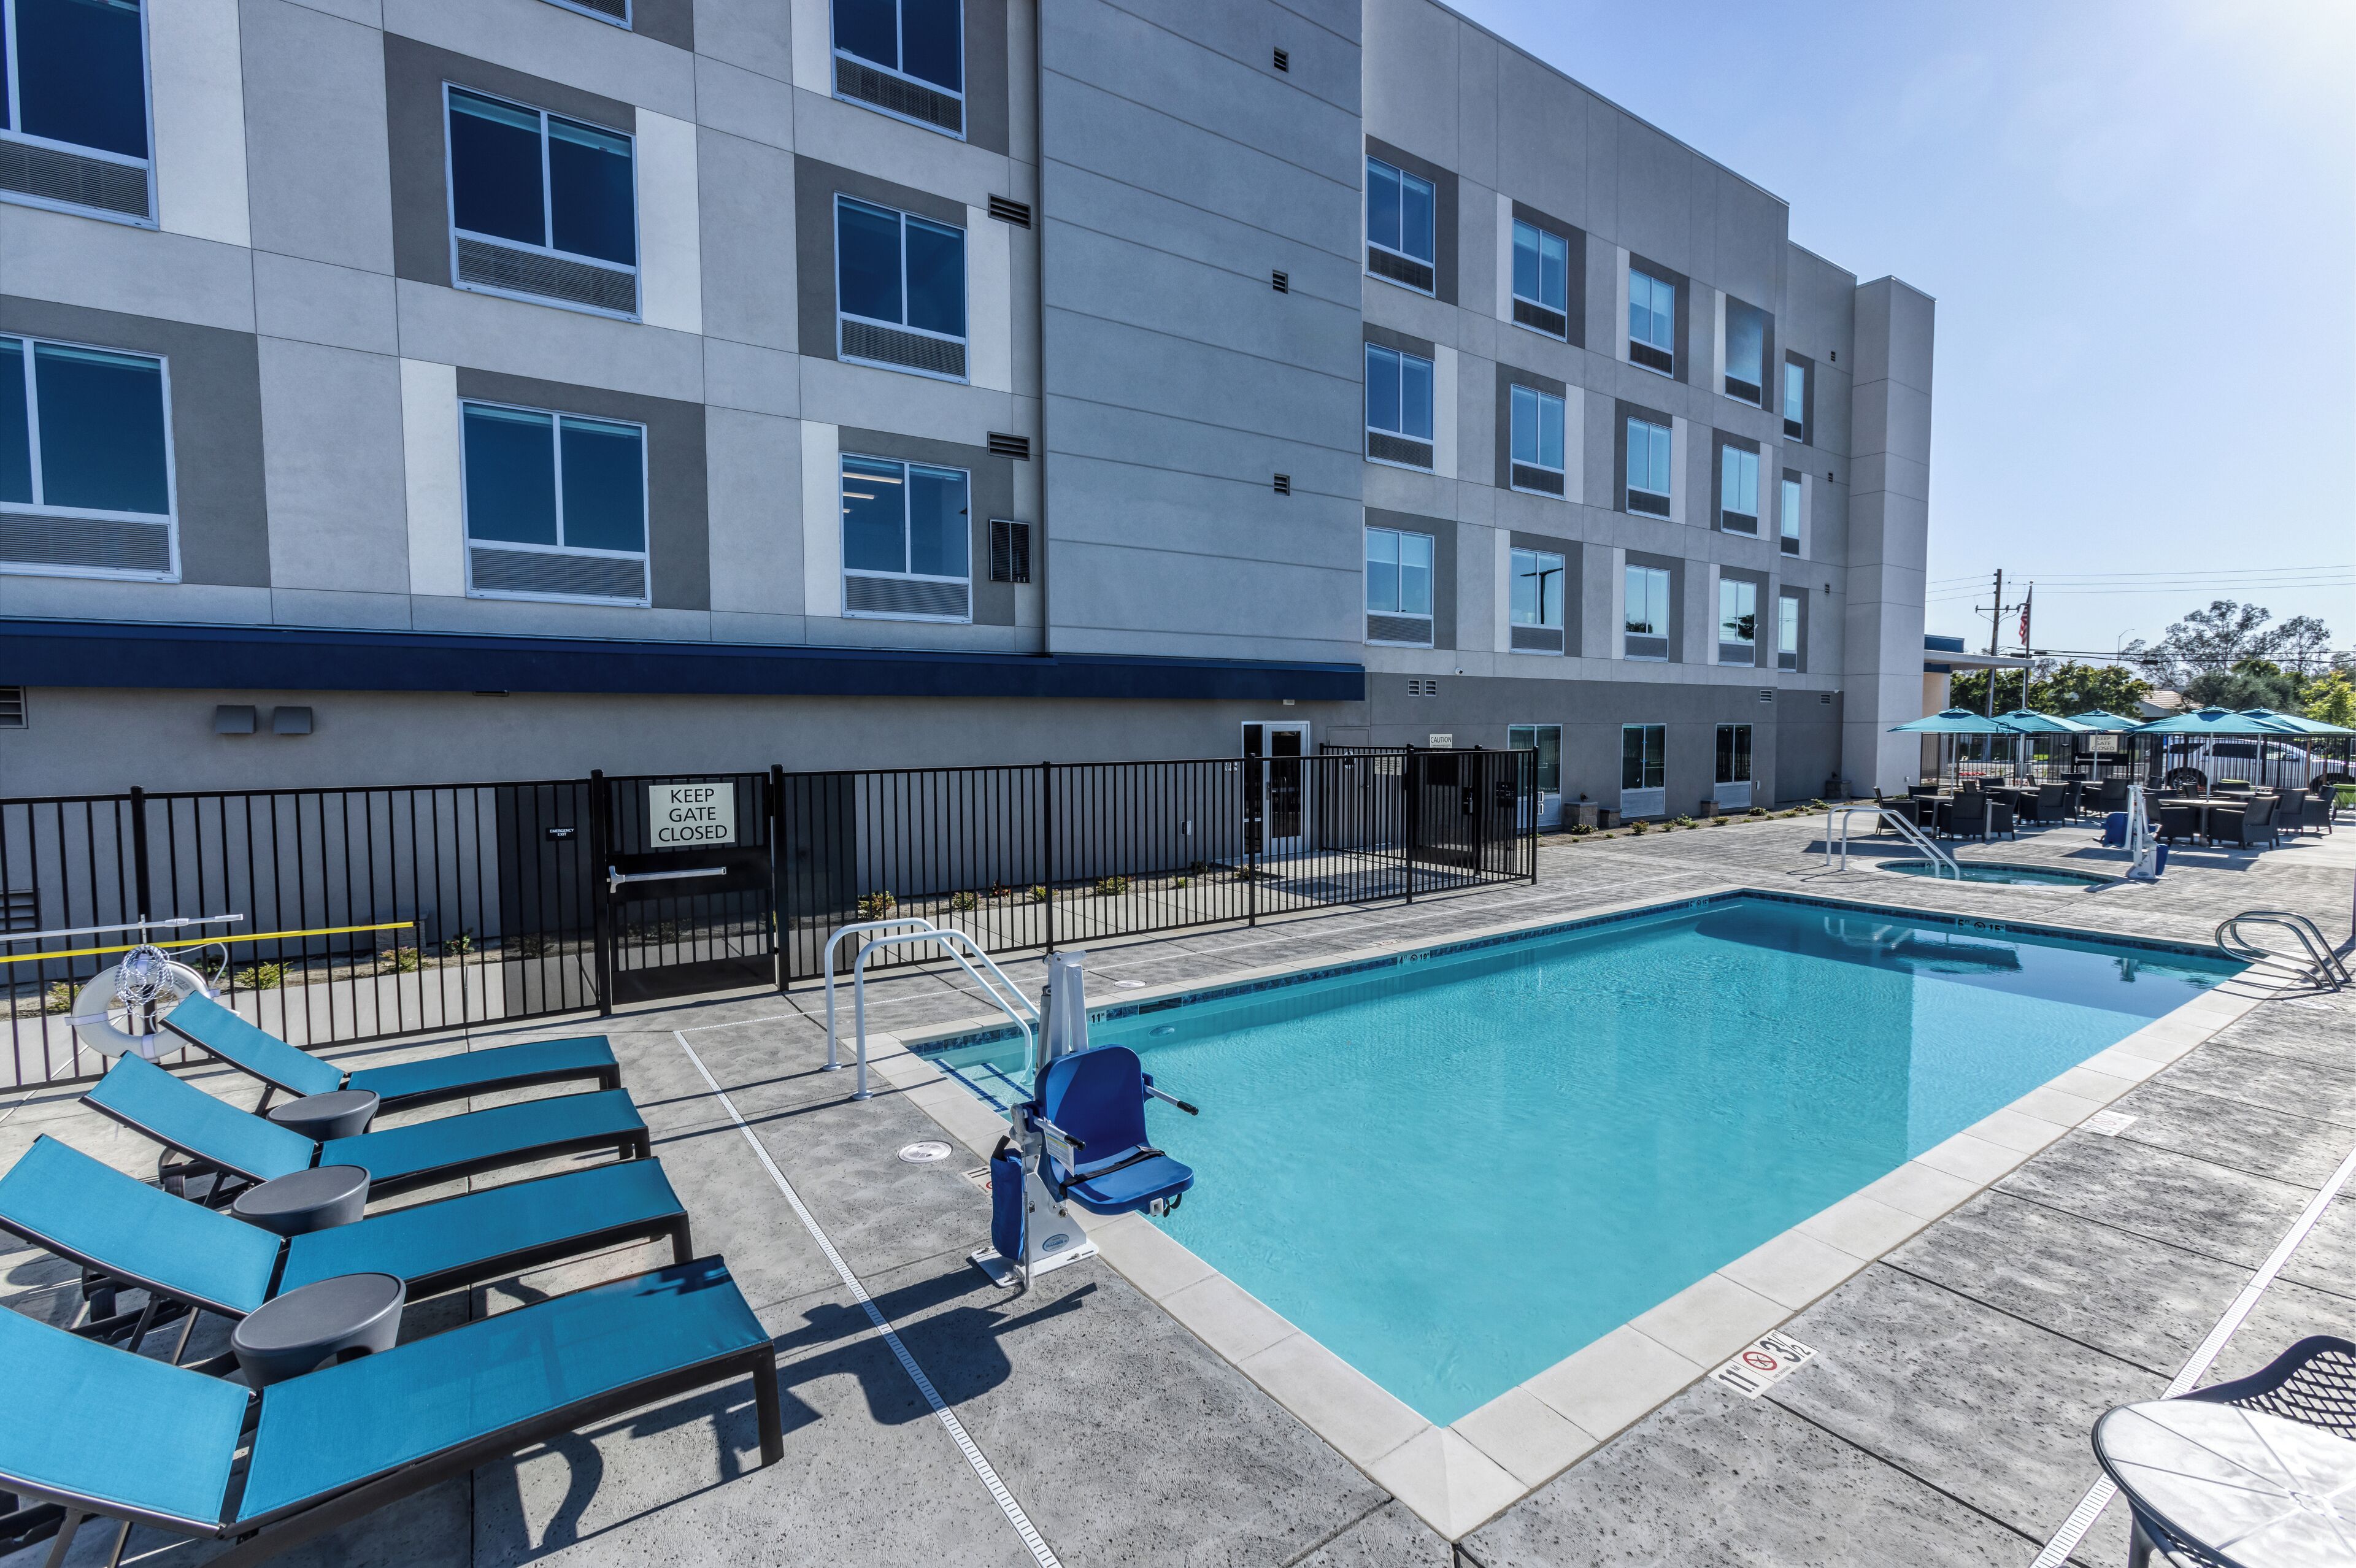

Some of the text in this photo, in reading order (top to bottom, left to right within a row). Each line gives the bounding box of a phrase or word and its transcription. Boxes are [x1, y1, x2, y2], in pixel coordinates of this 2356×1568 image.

[671, 788, 715, 804] KEEP
[669, 807, 717, 823] GATE
[658, 824, 728, 842] CLOSED
